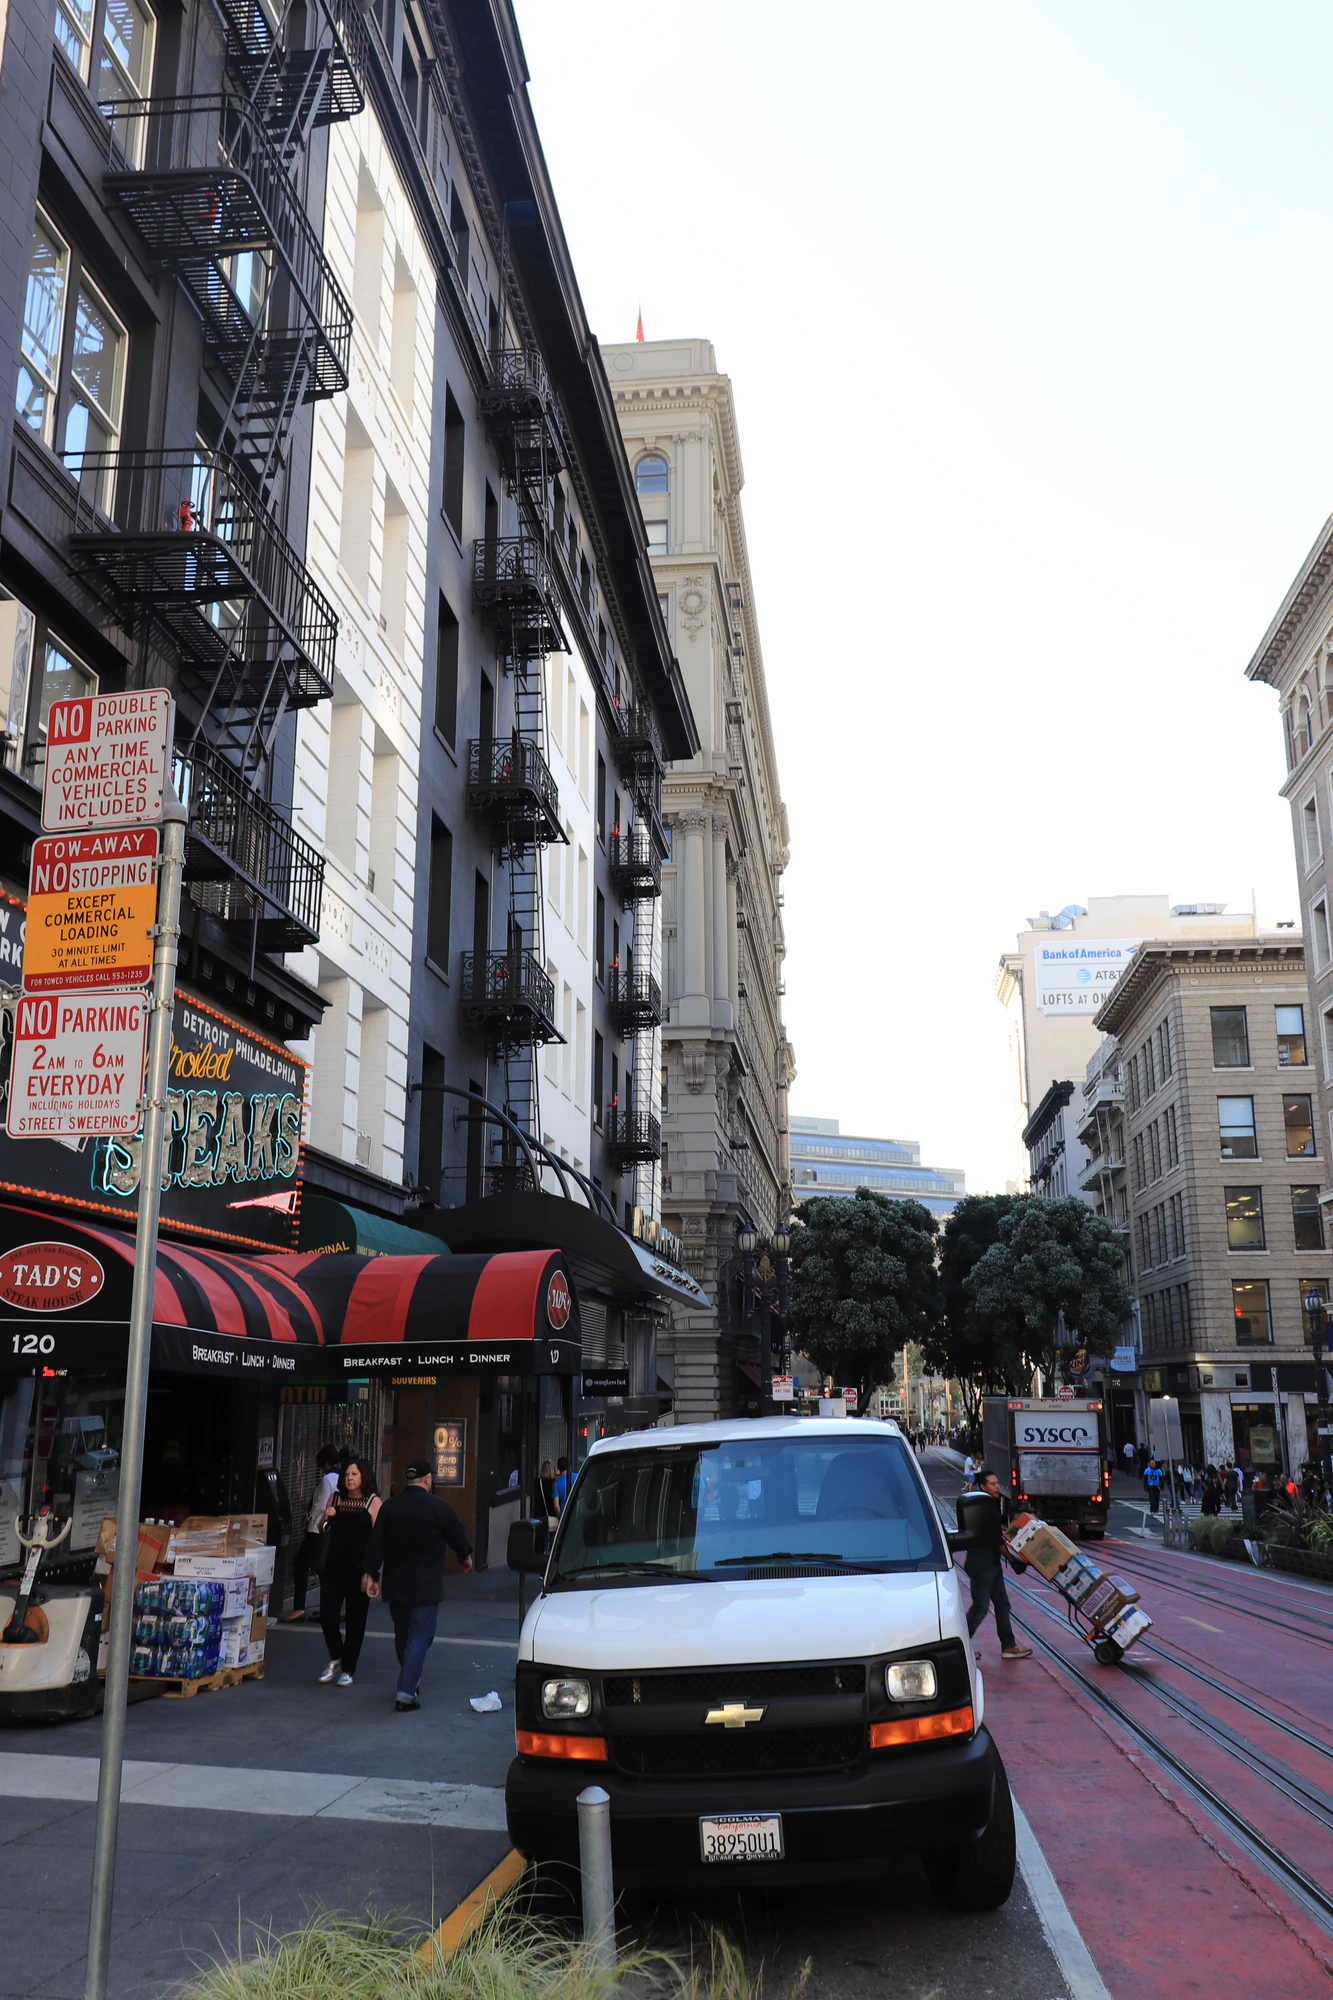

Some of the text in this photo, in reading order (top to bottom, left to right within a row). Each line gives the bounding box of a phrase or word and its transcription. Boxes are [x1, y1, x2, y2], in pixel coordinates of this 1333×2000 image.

[98, 695, 158, 717] DOUBLE
[54, 704, 84, 738] NO
[97, 716, 157, 737] PARKING
[64, 740, 149, 765] ANY TIME
[51, 758, 159, 784] COMMERCIAL
[62, 777, 147, 801] VEHICLES
[59, 796, 146, 820] INCLUDED
[43, 833, 145, 860] TOW-AWAY
[35, 862, 147, 893] NO STOPPING
[67, 894, 116, 910] EXCEPT
[44, 907, 135, 927] COMMERCIAL
[60, 924, 118, 941] LOADING
[51, 942, 126, 958] 30 MINUTE LIMIT
[1043, 948, 1122, 959] Bank of America
[58, 955, 117, 968] AT ALL TIMES
[30, 970, 143, 987] FOR TOWED VEHICLES CALL 553-1235
[1095, 970, 1123, 981] AT&T
[1042, 992, 1108, 1005] LOFTS AT ON
[20, 1000, 140, 1036] NO PARKING
[183, 1009, 297, 1086] DETROIT PHILADELPHIA
[74, 1059, 83, 1069] TO
[27, 1073, 126, 1097] EVERYDAY
[29, 1099, 120, 1111] INCLUDING HOLIDAYS
[19, 1115, 129, 1131] STREET SWEEPING
[58, 1247, 89, 1265] Francisco
[301, 1241, 350, 1254] RIGINAL
[13, 1264, 82, 1288] TAD'S
[2, 1287, 84, 1309] STEAK HOUSE
[12, 1334, 55, 1354] 120
[192, 1344, 296, 1371] BREAKFAST LUNCH DINNER
[343, 1353, 511, 1367] BREAKFAST LUNCH DINNER
[391, 1376, 437, 1386] SOUVENIRS
[281, 1386, 327, 1404] ATM
[1024, 1427, 1089, 1443] SYSCO
[438, 1455, 457, 1464] Zero
[437, 1465, 457, 1474] Fees
[717, 1822, 766, 1832] California
[707, 1832, 778, 1855] 38950U1
